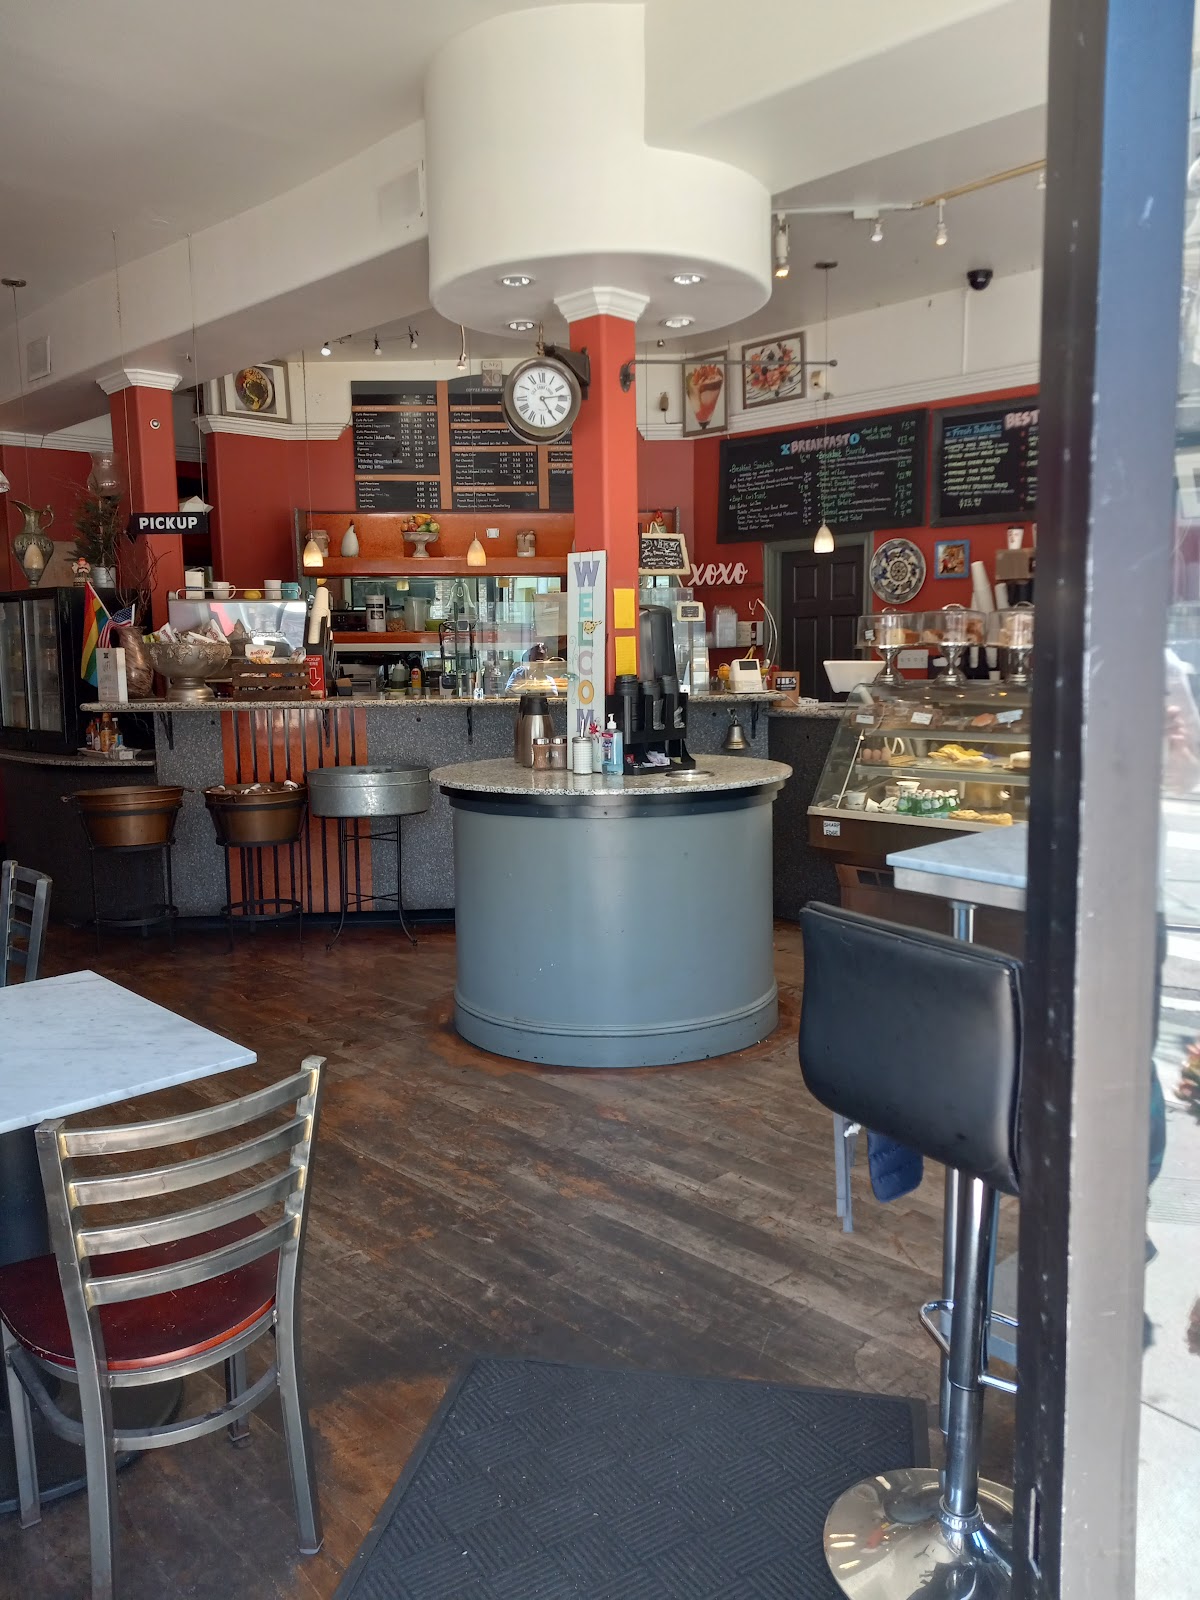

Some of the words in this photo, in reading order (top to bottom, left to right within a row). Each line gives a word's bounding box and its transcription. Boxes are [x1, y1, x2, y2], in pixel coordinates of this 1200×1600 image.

[1005, 410, 1040, 431] BEST
[791, 433, 851, 454] BREAKFAST
[138, 516, 198, 530] PICKUP
[688, 562, 748, 586] xoxo
[574, 560, 600, 732] WELCOM
